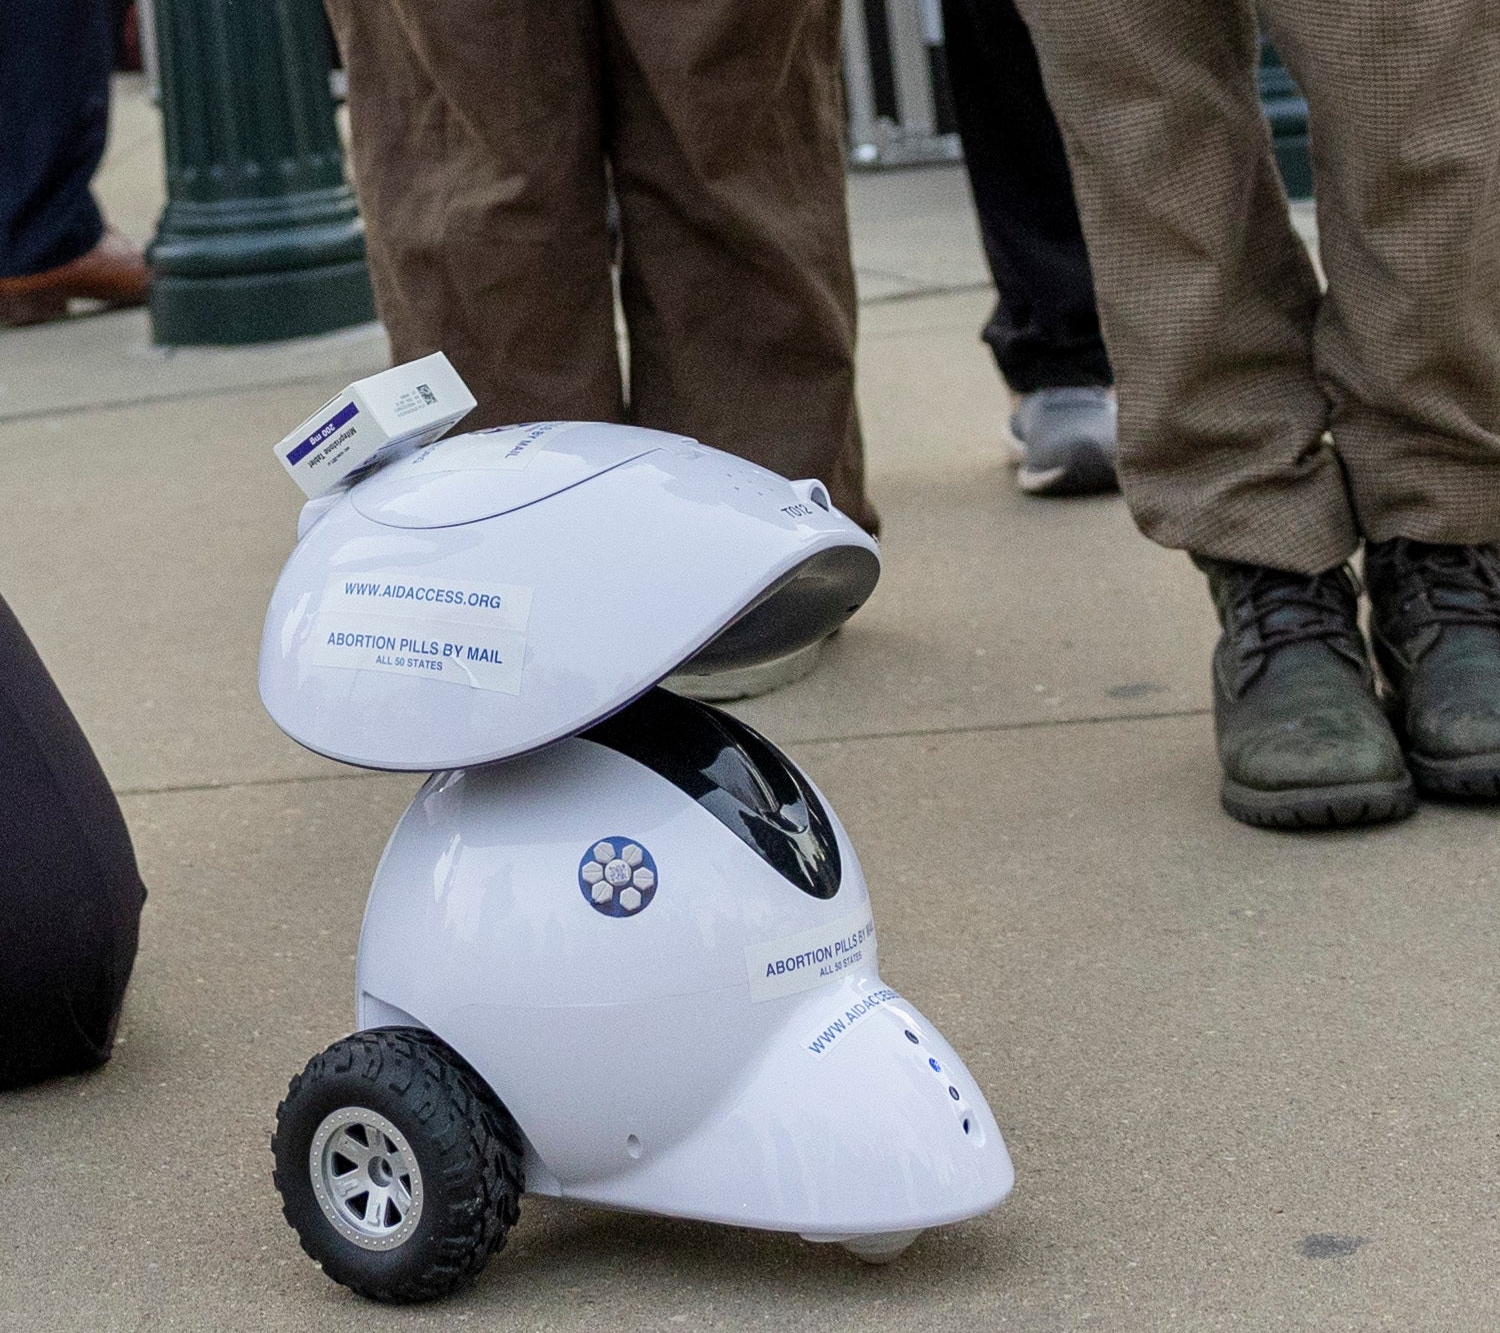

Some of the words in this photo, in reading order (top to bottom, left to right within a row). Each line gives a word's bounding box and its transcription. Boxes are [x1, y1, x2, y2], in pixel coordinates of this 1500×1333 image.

[344, 582, 501, 609] WWW.AIDACCESS.ORG
[327, 632, 396, 651] ABORTION
[399, 638, 439, 655] PILLS
[442, 643, 464, 658] BY
[466, 646, 503, 665] MAIL
[375, 655, 394, 666] ALL
[394, 657, 405, 667] 50
[407, 658, 444, 671] STATES
[766, 945, 833, 978] ABORTION
[834, 934, 858, 956] PILLS
[819, 966, 834, 978] ALL
[834, 960, 843, 971] 50
[843, 950, 862, 969] STATES
